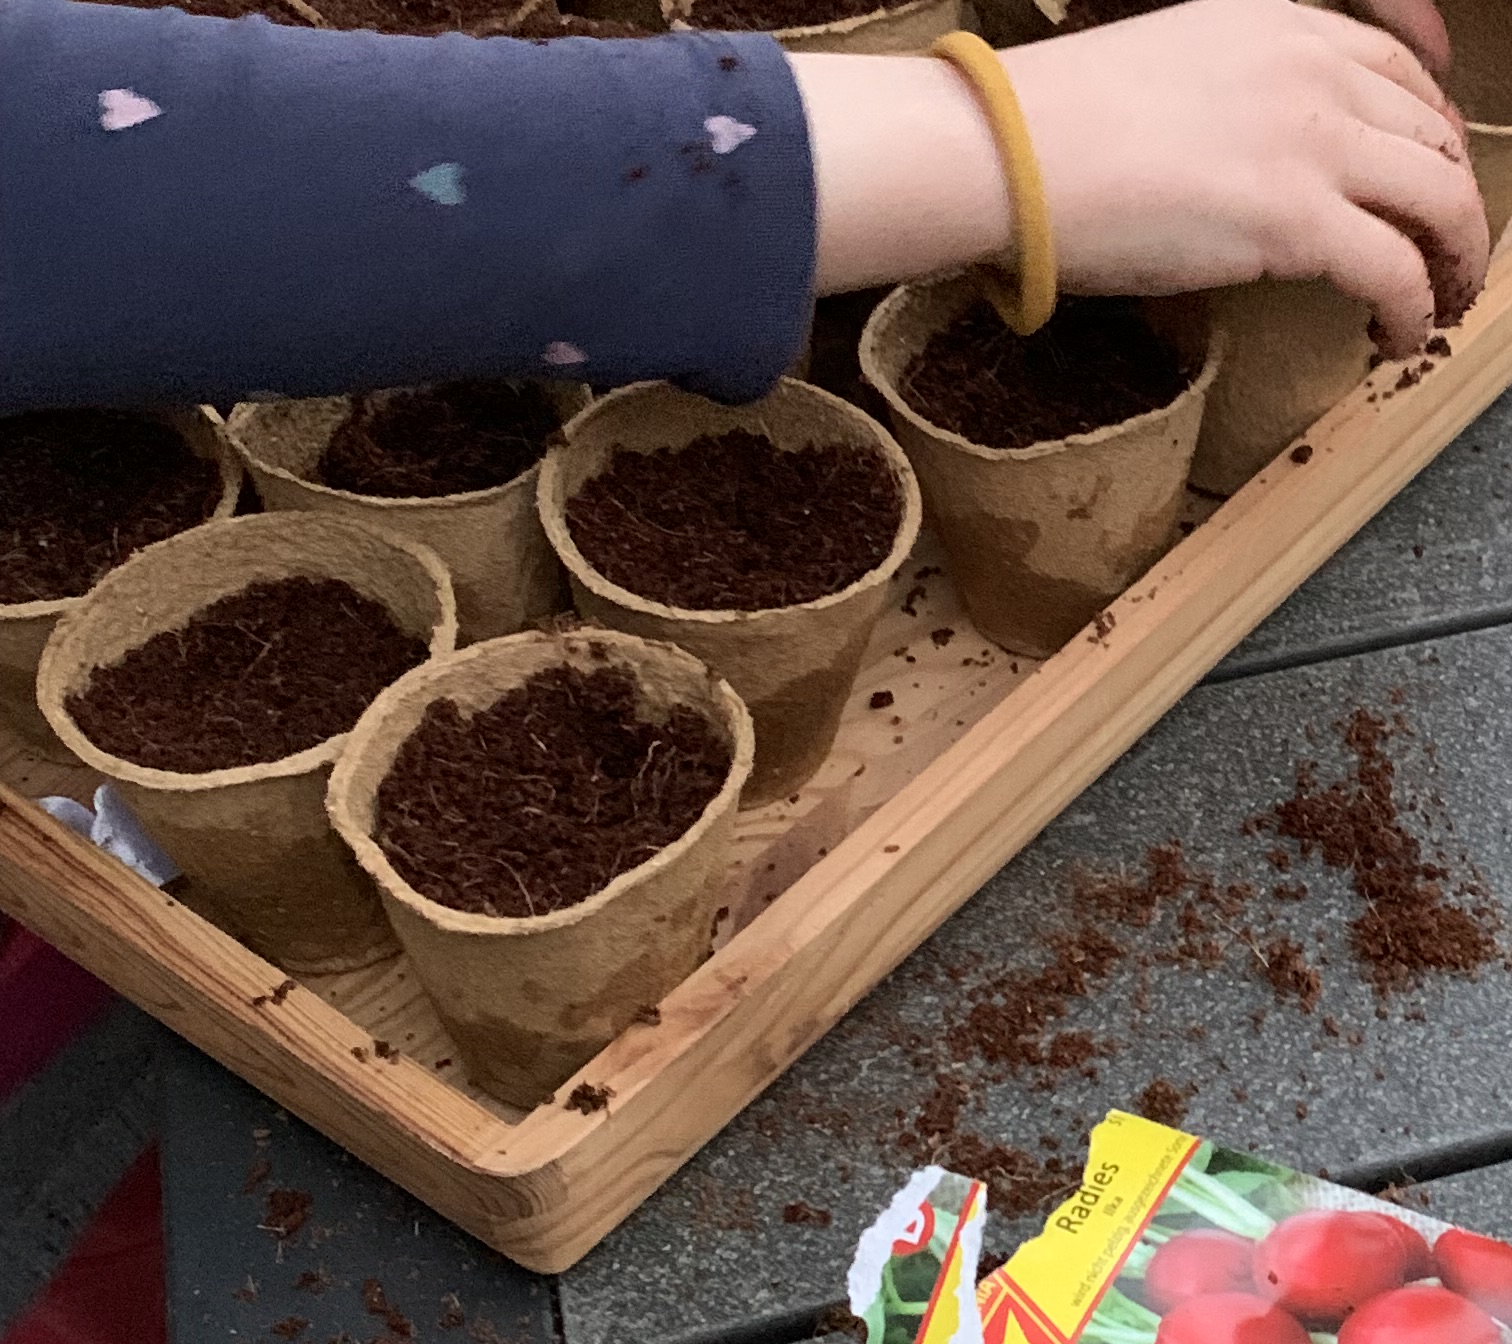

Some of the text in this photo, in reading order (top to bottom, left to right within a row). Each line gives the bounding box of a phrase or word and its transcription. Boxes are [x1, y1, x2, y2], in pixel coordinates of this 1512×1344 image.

[1055, 1161, 1120, 1235] Radies
[1070, 1280, 1092, 1308] wird
[1086, 1256, 1109, 1284] nicht
